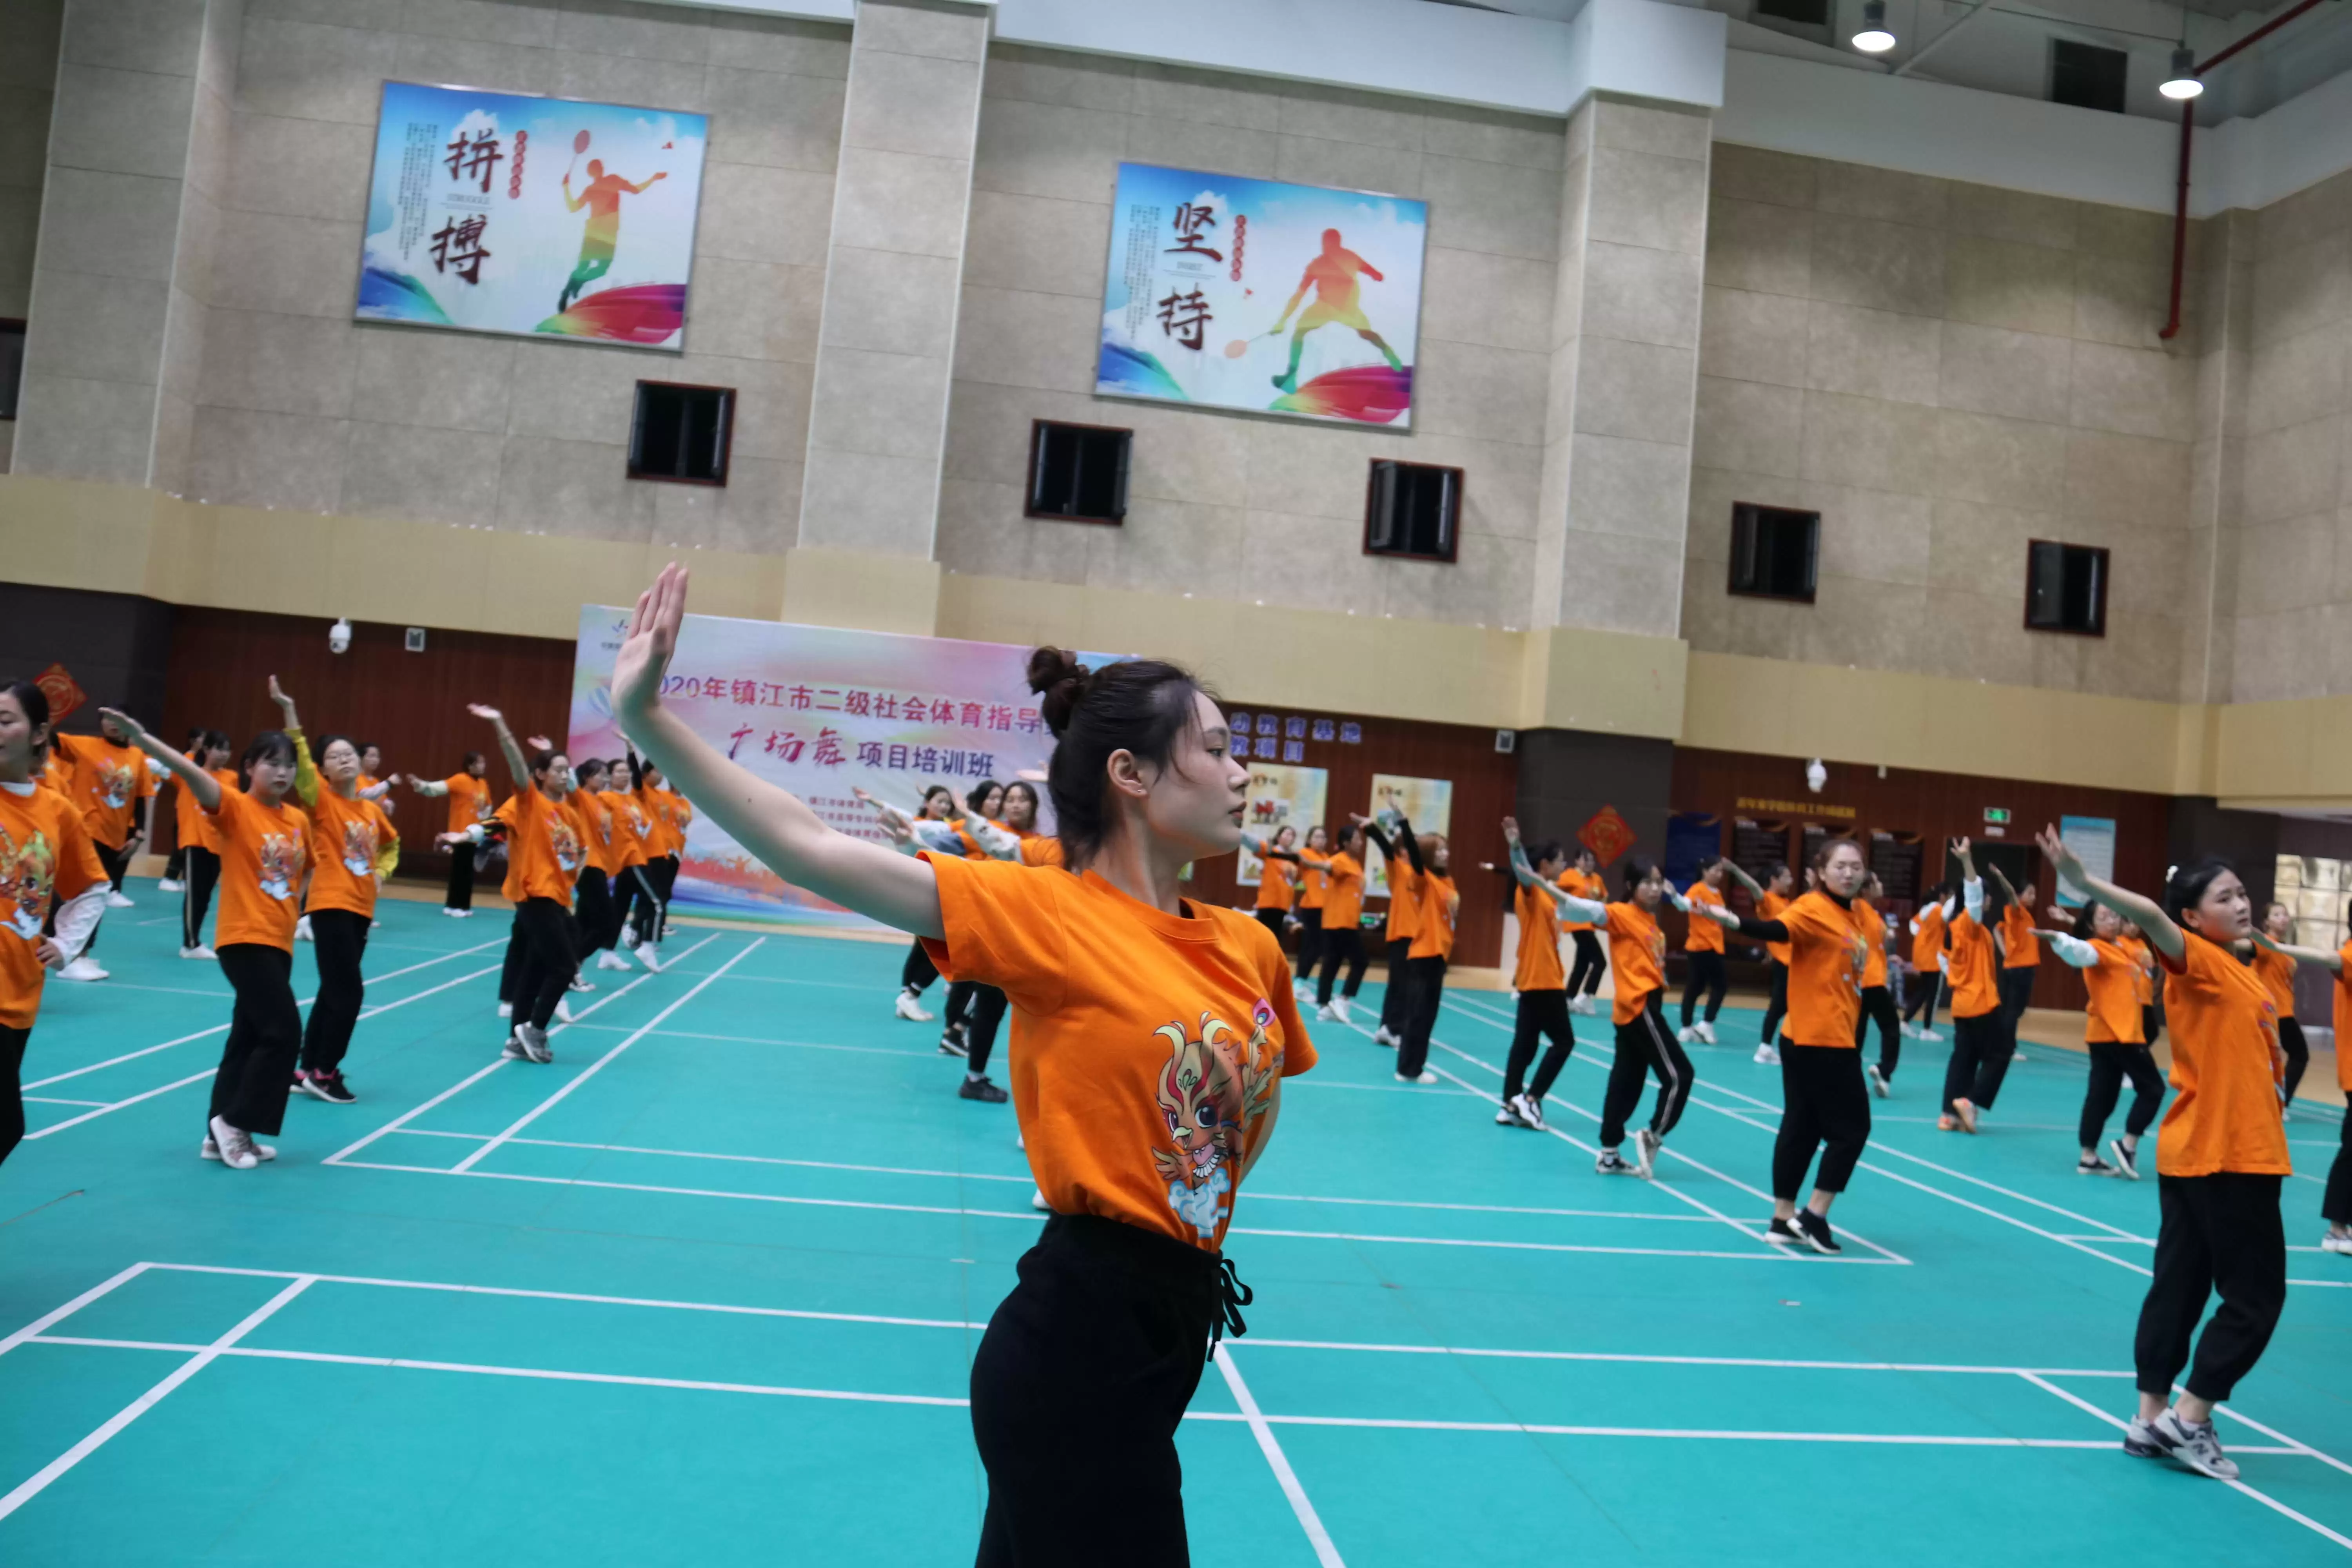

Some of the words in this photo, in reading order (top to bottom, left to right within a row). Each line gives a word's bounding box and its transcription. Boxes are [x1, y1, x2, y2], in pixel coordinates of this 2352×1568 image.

[428, 129, 503, 285] 拼搏
[1156, 201, 1223, 351] 坚持
[659, 675, 1053, 734] 020年镇江市二级社会体育指导
